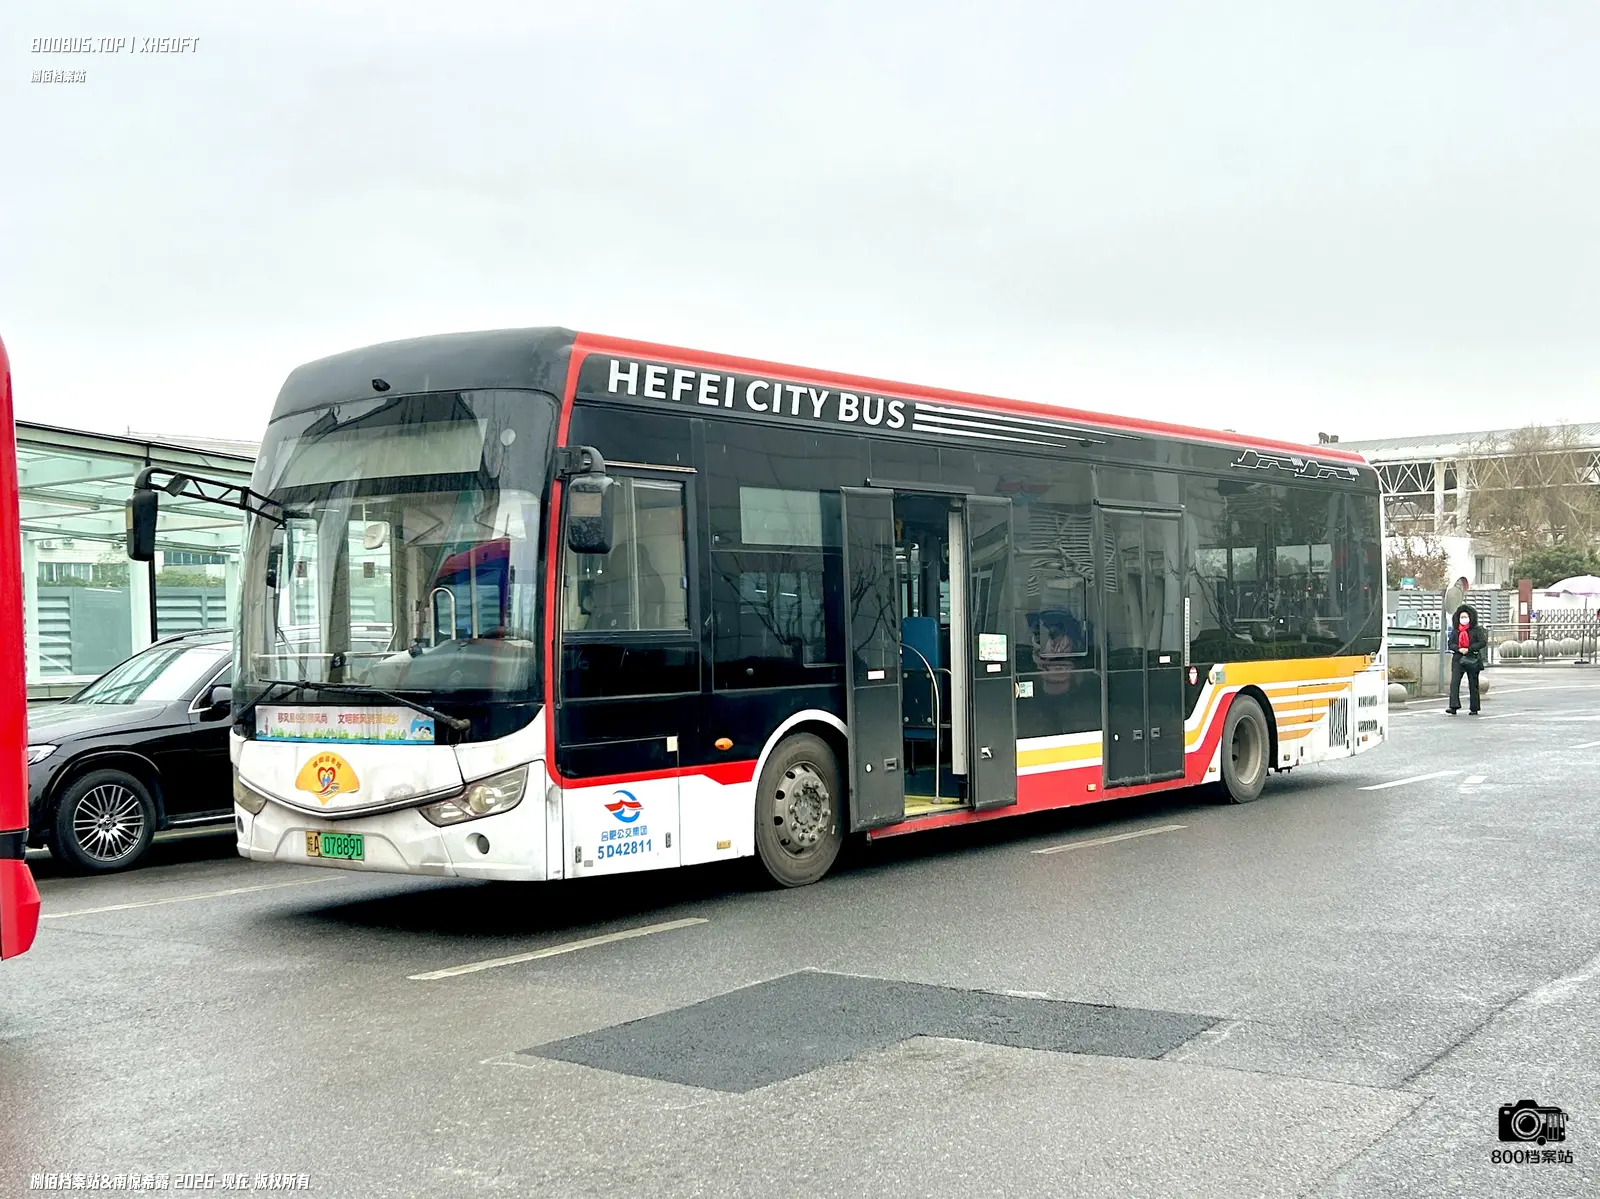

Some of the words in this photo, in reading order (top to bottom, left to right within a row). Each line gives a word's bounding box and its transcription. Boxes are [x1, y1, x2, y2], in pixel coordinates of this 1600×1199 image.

[607, 359, 736, 408] HEFEI
[745, 379, 830, 419] CITY
[837, 391, 906, 430] BUS
[601, 825, 648, 842] 合肥公交集团
[597, 839, 652, 860] 5D42811
